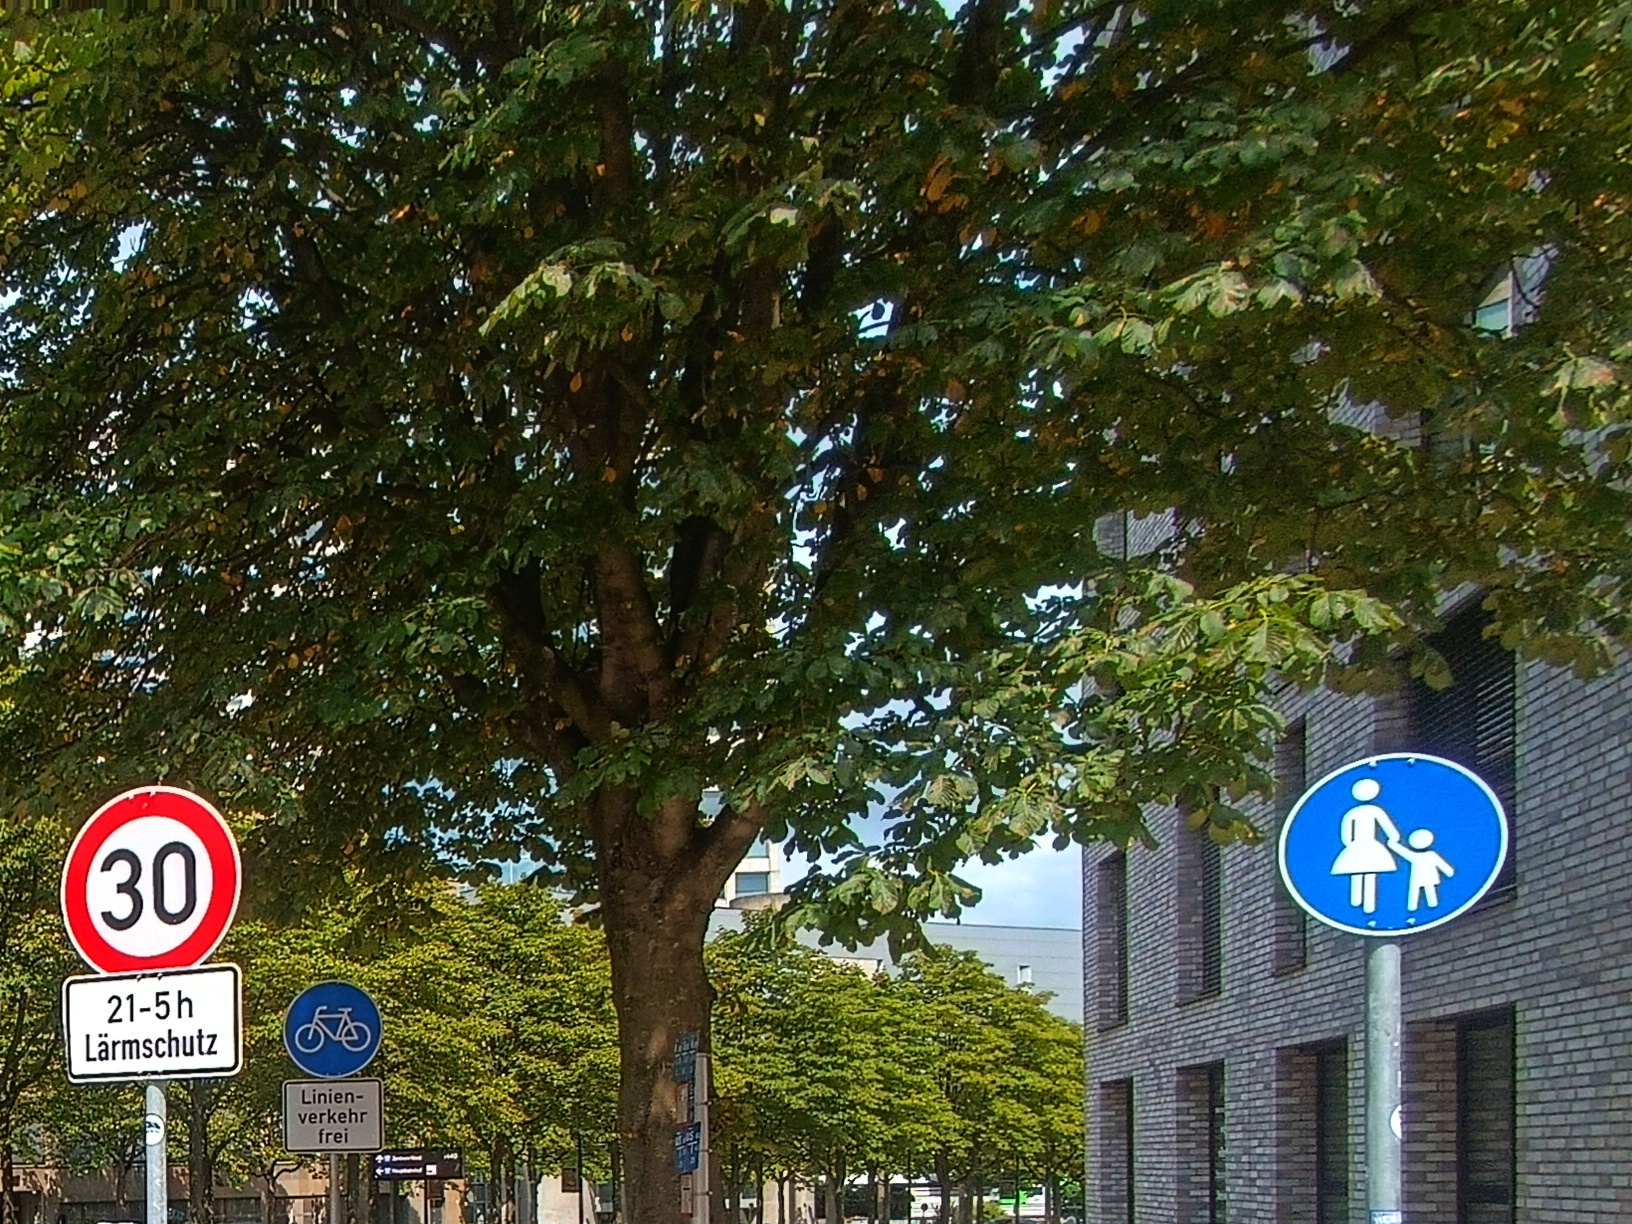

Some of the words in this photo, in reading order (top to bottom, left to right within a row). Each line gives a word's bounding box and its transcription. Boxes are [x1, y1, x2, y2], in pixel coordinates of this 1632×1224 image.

[99, 841, 197, 932] 30
[85, 1028, 218, 1062] Lärmschutz
[301, 1089, 364, 1105] Linien-
[297, 1108, 368, 1125] verkehr
[319, 1128, 348, 1144] frei
